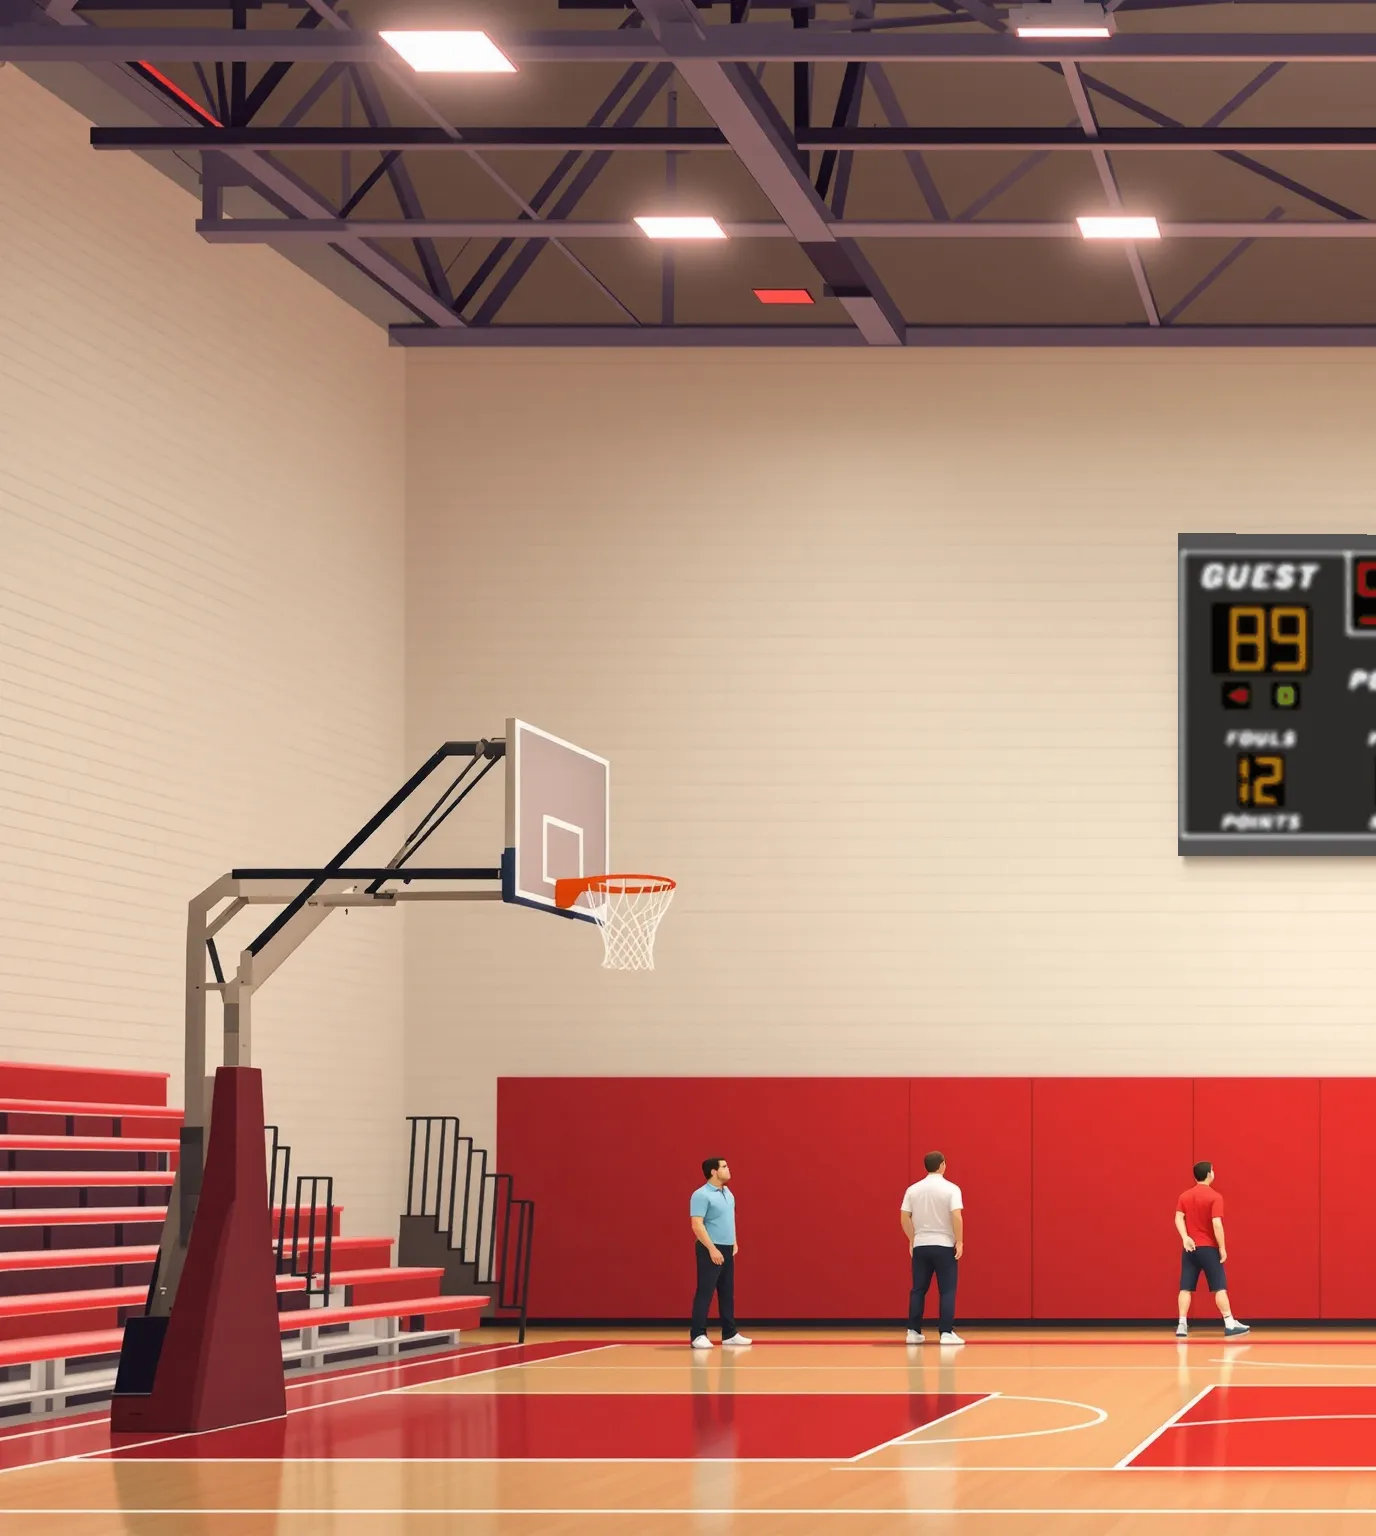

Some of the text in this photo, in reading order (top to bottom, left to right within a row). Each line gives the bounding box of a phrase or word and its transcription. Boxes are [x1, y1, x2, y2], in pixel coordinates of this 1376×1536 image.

[1201, 563, 1319, 589] GUEST
[1229, 606, 1307, 672] 89
[1239, 756, 1284, 805] 12
[1221, 814, 1300, 830] POINTS
